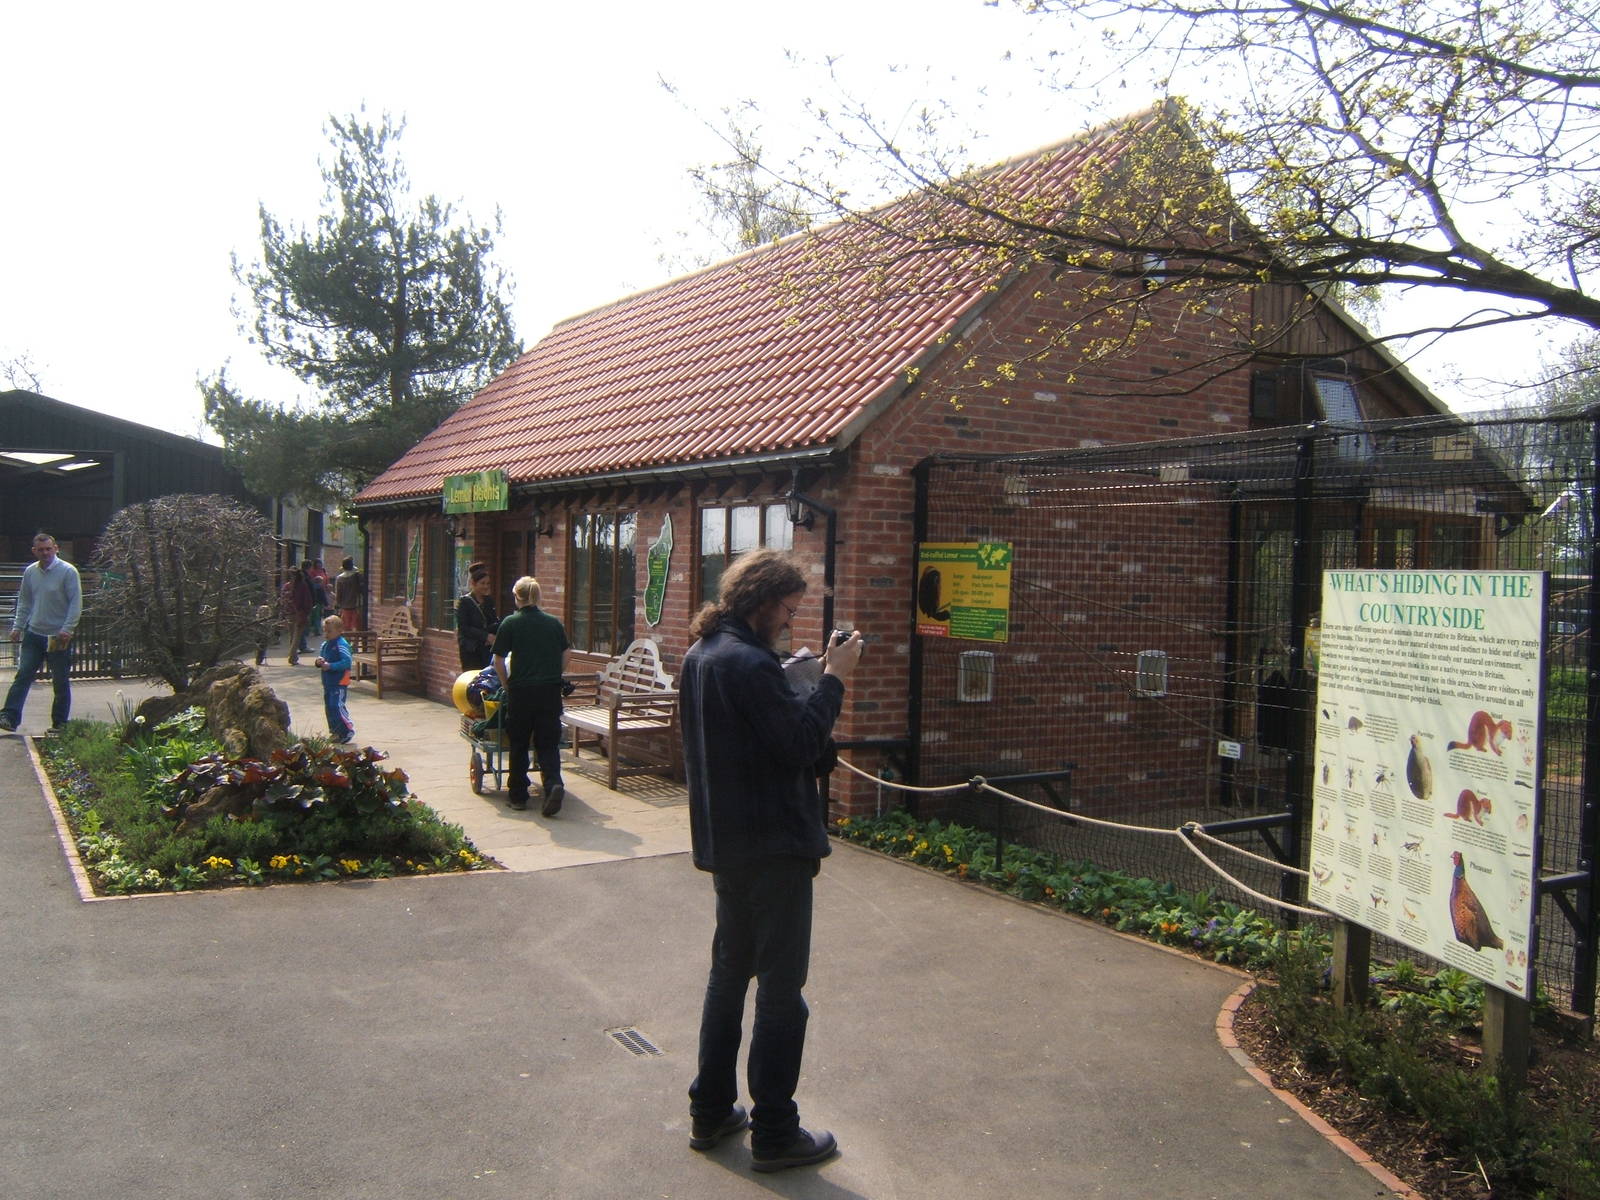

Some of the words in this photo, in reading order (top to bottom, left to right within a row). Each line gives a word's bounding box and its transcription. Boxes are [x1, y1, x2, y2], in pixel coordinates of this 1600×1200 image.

[473, 484, 500, 507] Heights
[1330, 573, 1389, 593] WHAT'S
[1392, 574, 1457, 595] HIDING
[1462, 575, 1482, 596] IN
[1488, 576, 1532, 598] THE
[1360, 602, 1485, 630] COUNTRYSIDE
[1479, 635, 1495, 644] which
[1472, 680, 1486, 690] Some
[1486, 695, 1506, 704] around
